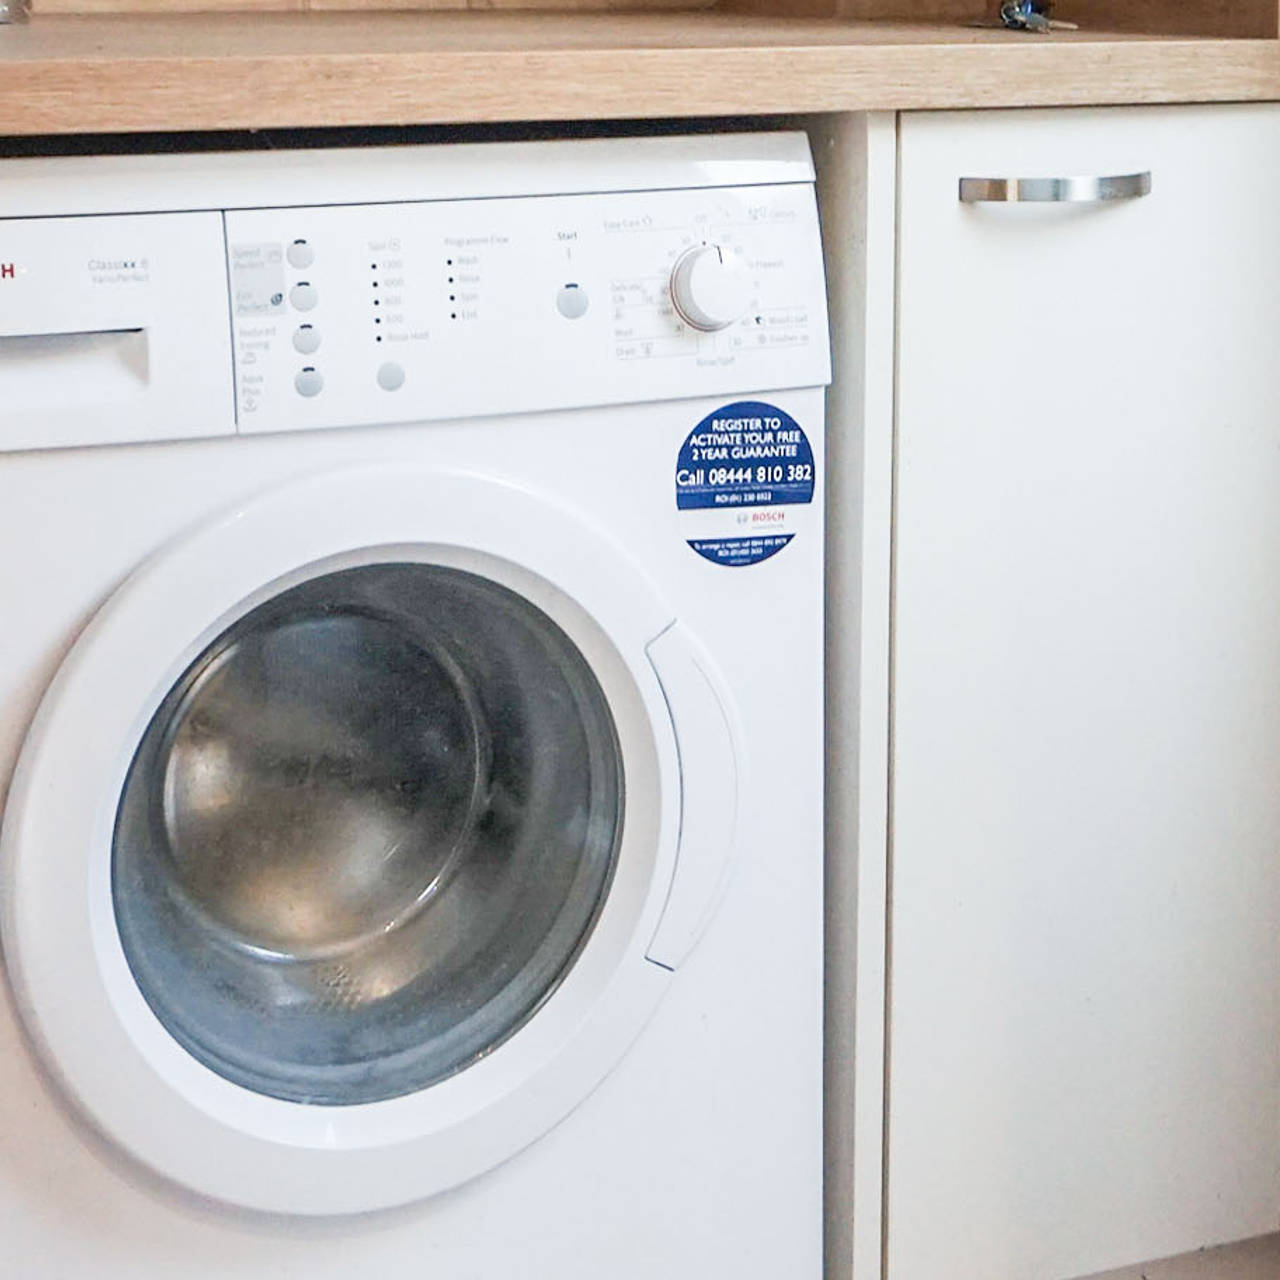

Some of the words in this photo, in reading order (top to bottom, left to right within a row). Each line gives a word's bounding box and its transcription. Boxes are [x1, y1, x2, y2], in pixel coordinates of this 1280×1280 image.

[712, 418, 762, 431] REGISTER
[763, 417, 781, 430] TO
[689, 433, 742, 446] ACTIVATE
[743, 432, 774, 445] YOUR
[776, 430, 801, 443] FREE
[692, 450, 699, 461] 2
[699, 448, 729, 460] YEAR
[731, 445, 798, 459] GUARANTEE
[677, 470, 704, 486] Call
[708, 468, 752, 485] 08444
[756, 466, 783, 482] 810
[787, 464, 812, 481] 382
[752, 511, 785, 522] BOSCH
